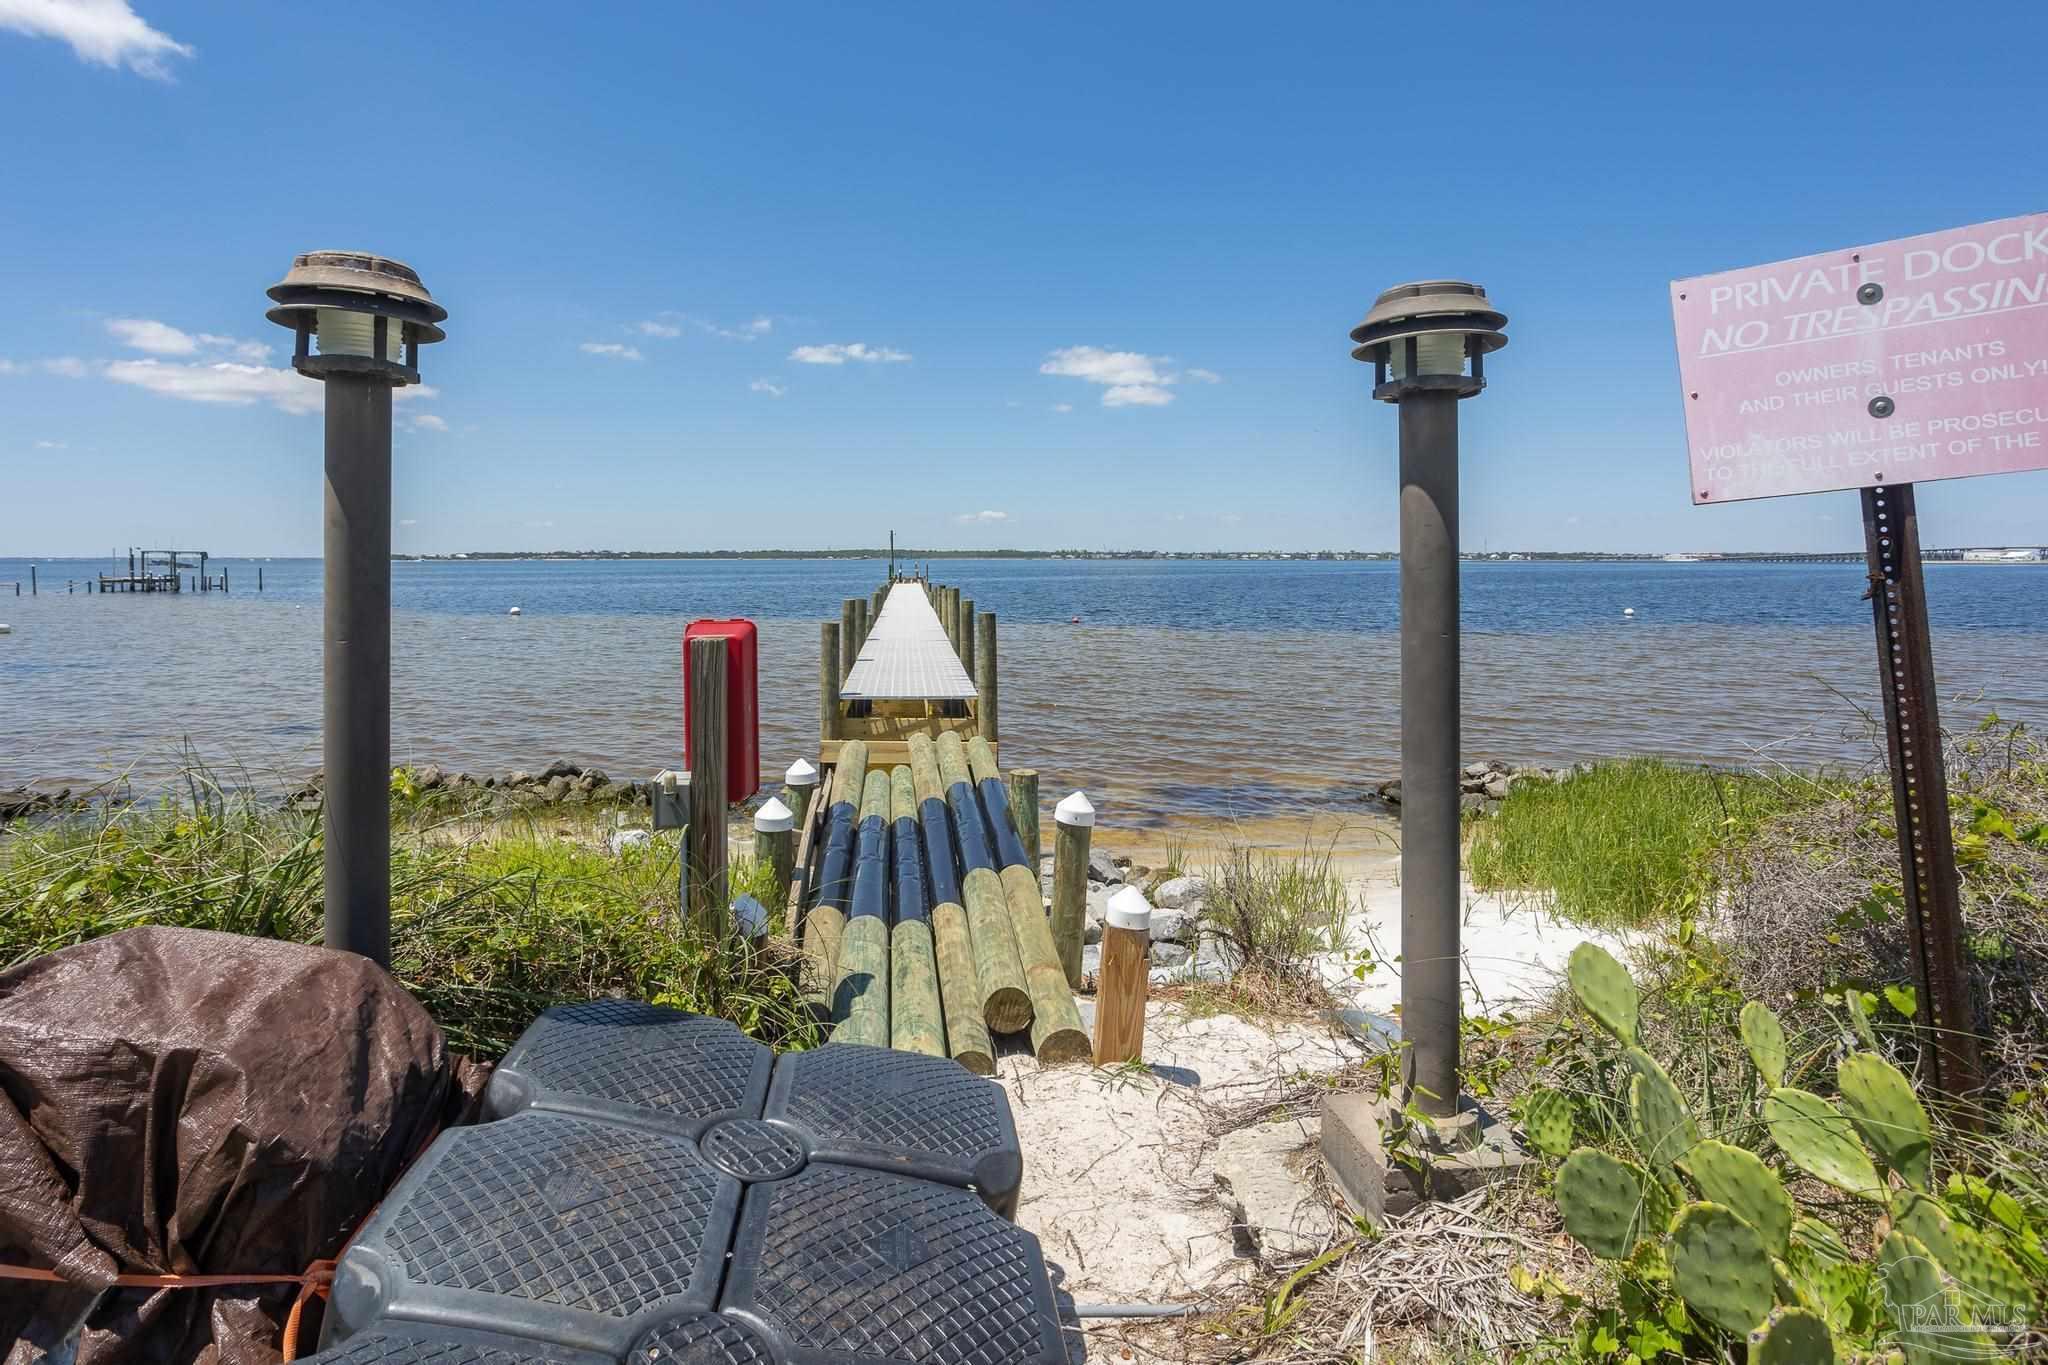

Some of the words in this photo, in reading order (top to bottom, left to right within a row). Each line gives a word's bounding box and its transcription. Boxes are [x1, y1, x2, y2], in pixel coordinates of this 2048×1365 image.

[1711, 257, 1887, 315] PRIVATE
[1904, 227, 2048, 281] DOCK
[1700, 320, 1769, 354] NO
[1783, 272, 2048, 341] TRESPASSIN
[1888, 340, 2006, 369] TENANTS
[1739, 395, 1785, 415] AND
[1791, 385, 1857, 407] THEIR
[1865, 371, 1963, 397] GUESTS
[1970, 359, 2048, 384] ONLY!
[1704, 465, 1733, 481] TO
[1848, 442, 1939, 466] EXTENT
[1948, 438, 1982, 456] OF
[1989, 432, 2041, 451] THE
[1828, 429, 1882, 449] WILL
[1888, 421, 1921, 440] BE
